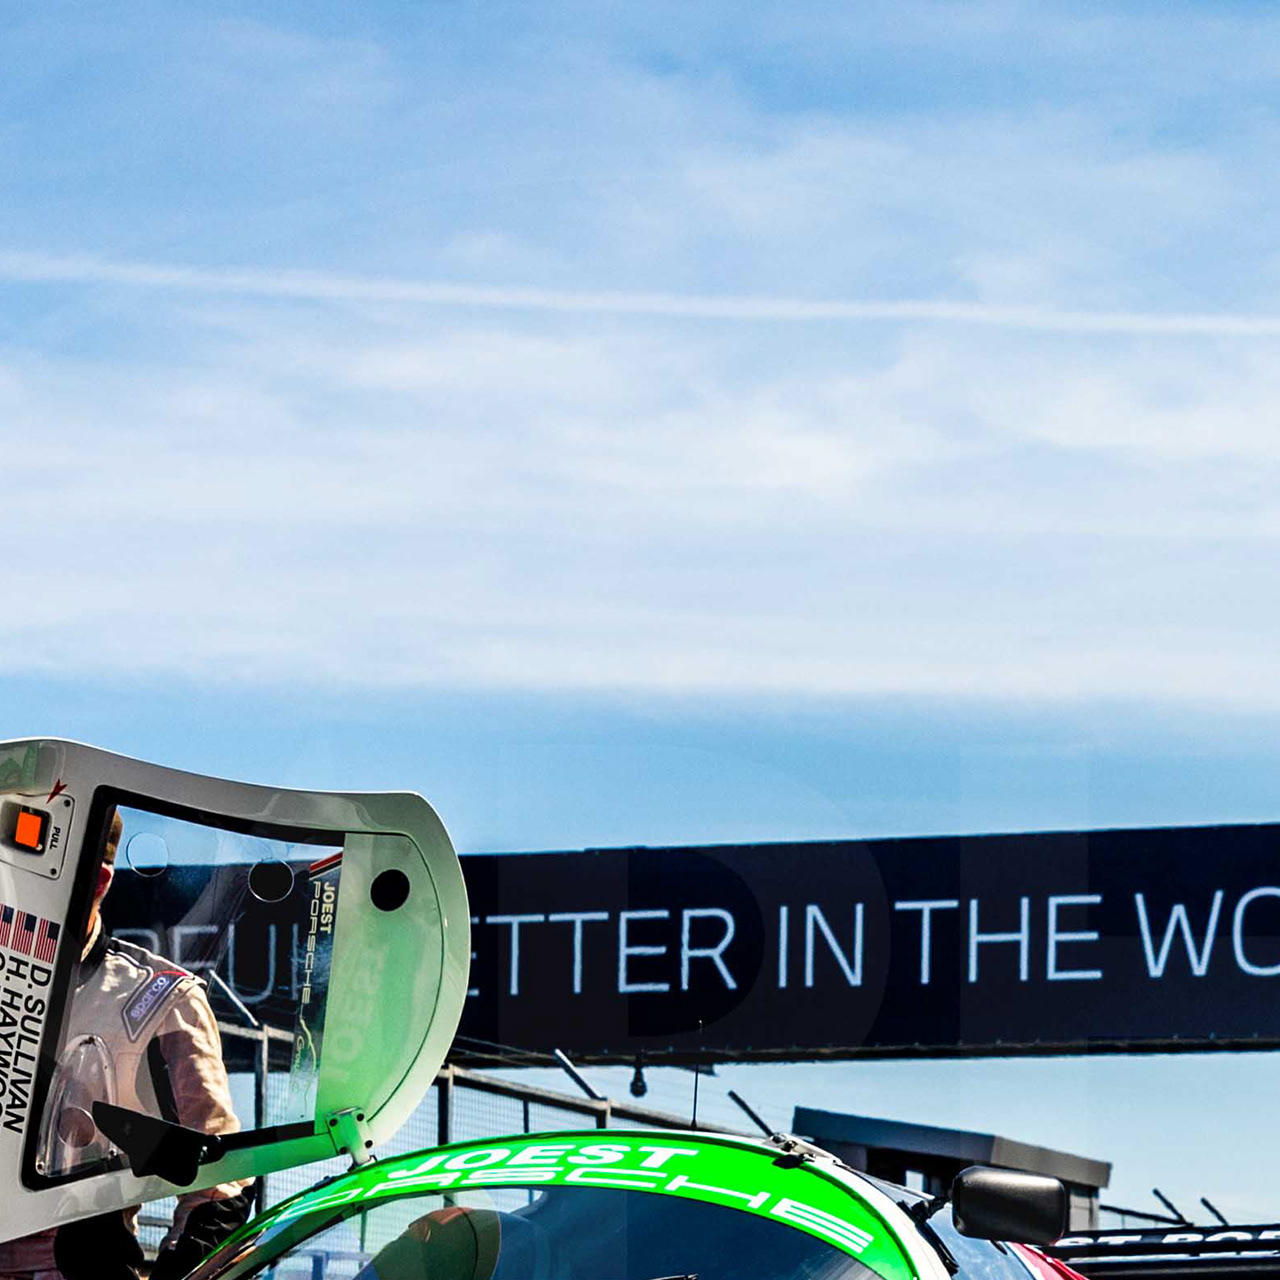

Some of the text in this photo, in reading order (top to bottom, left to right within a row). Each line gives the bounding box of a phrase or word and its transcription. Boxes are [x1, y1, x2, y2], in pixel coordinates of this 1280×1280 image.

[47, 825, 62, 850] PULL
[320, 881, 335, 934] JOEST
[301, 880, 322, 1004] PORSCHE
[776, 901, 865, 990] IN
[895, 893, 1105, 986] THE
[129, 975, 171, 1020] sparco
[3, 992, 47, 1134] SULLIVAN
[387, 1143, 699, 1180] JOEST
